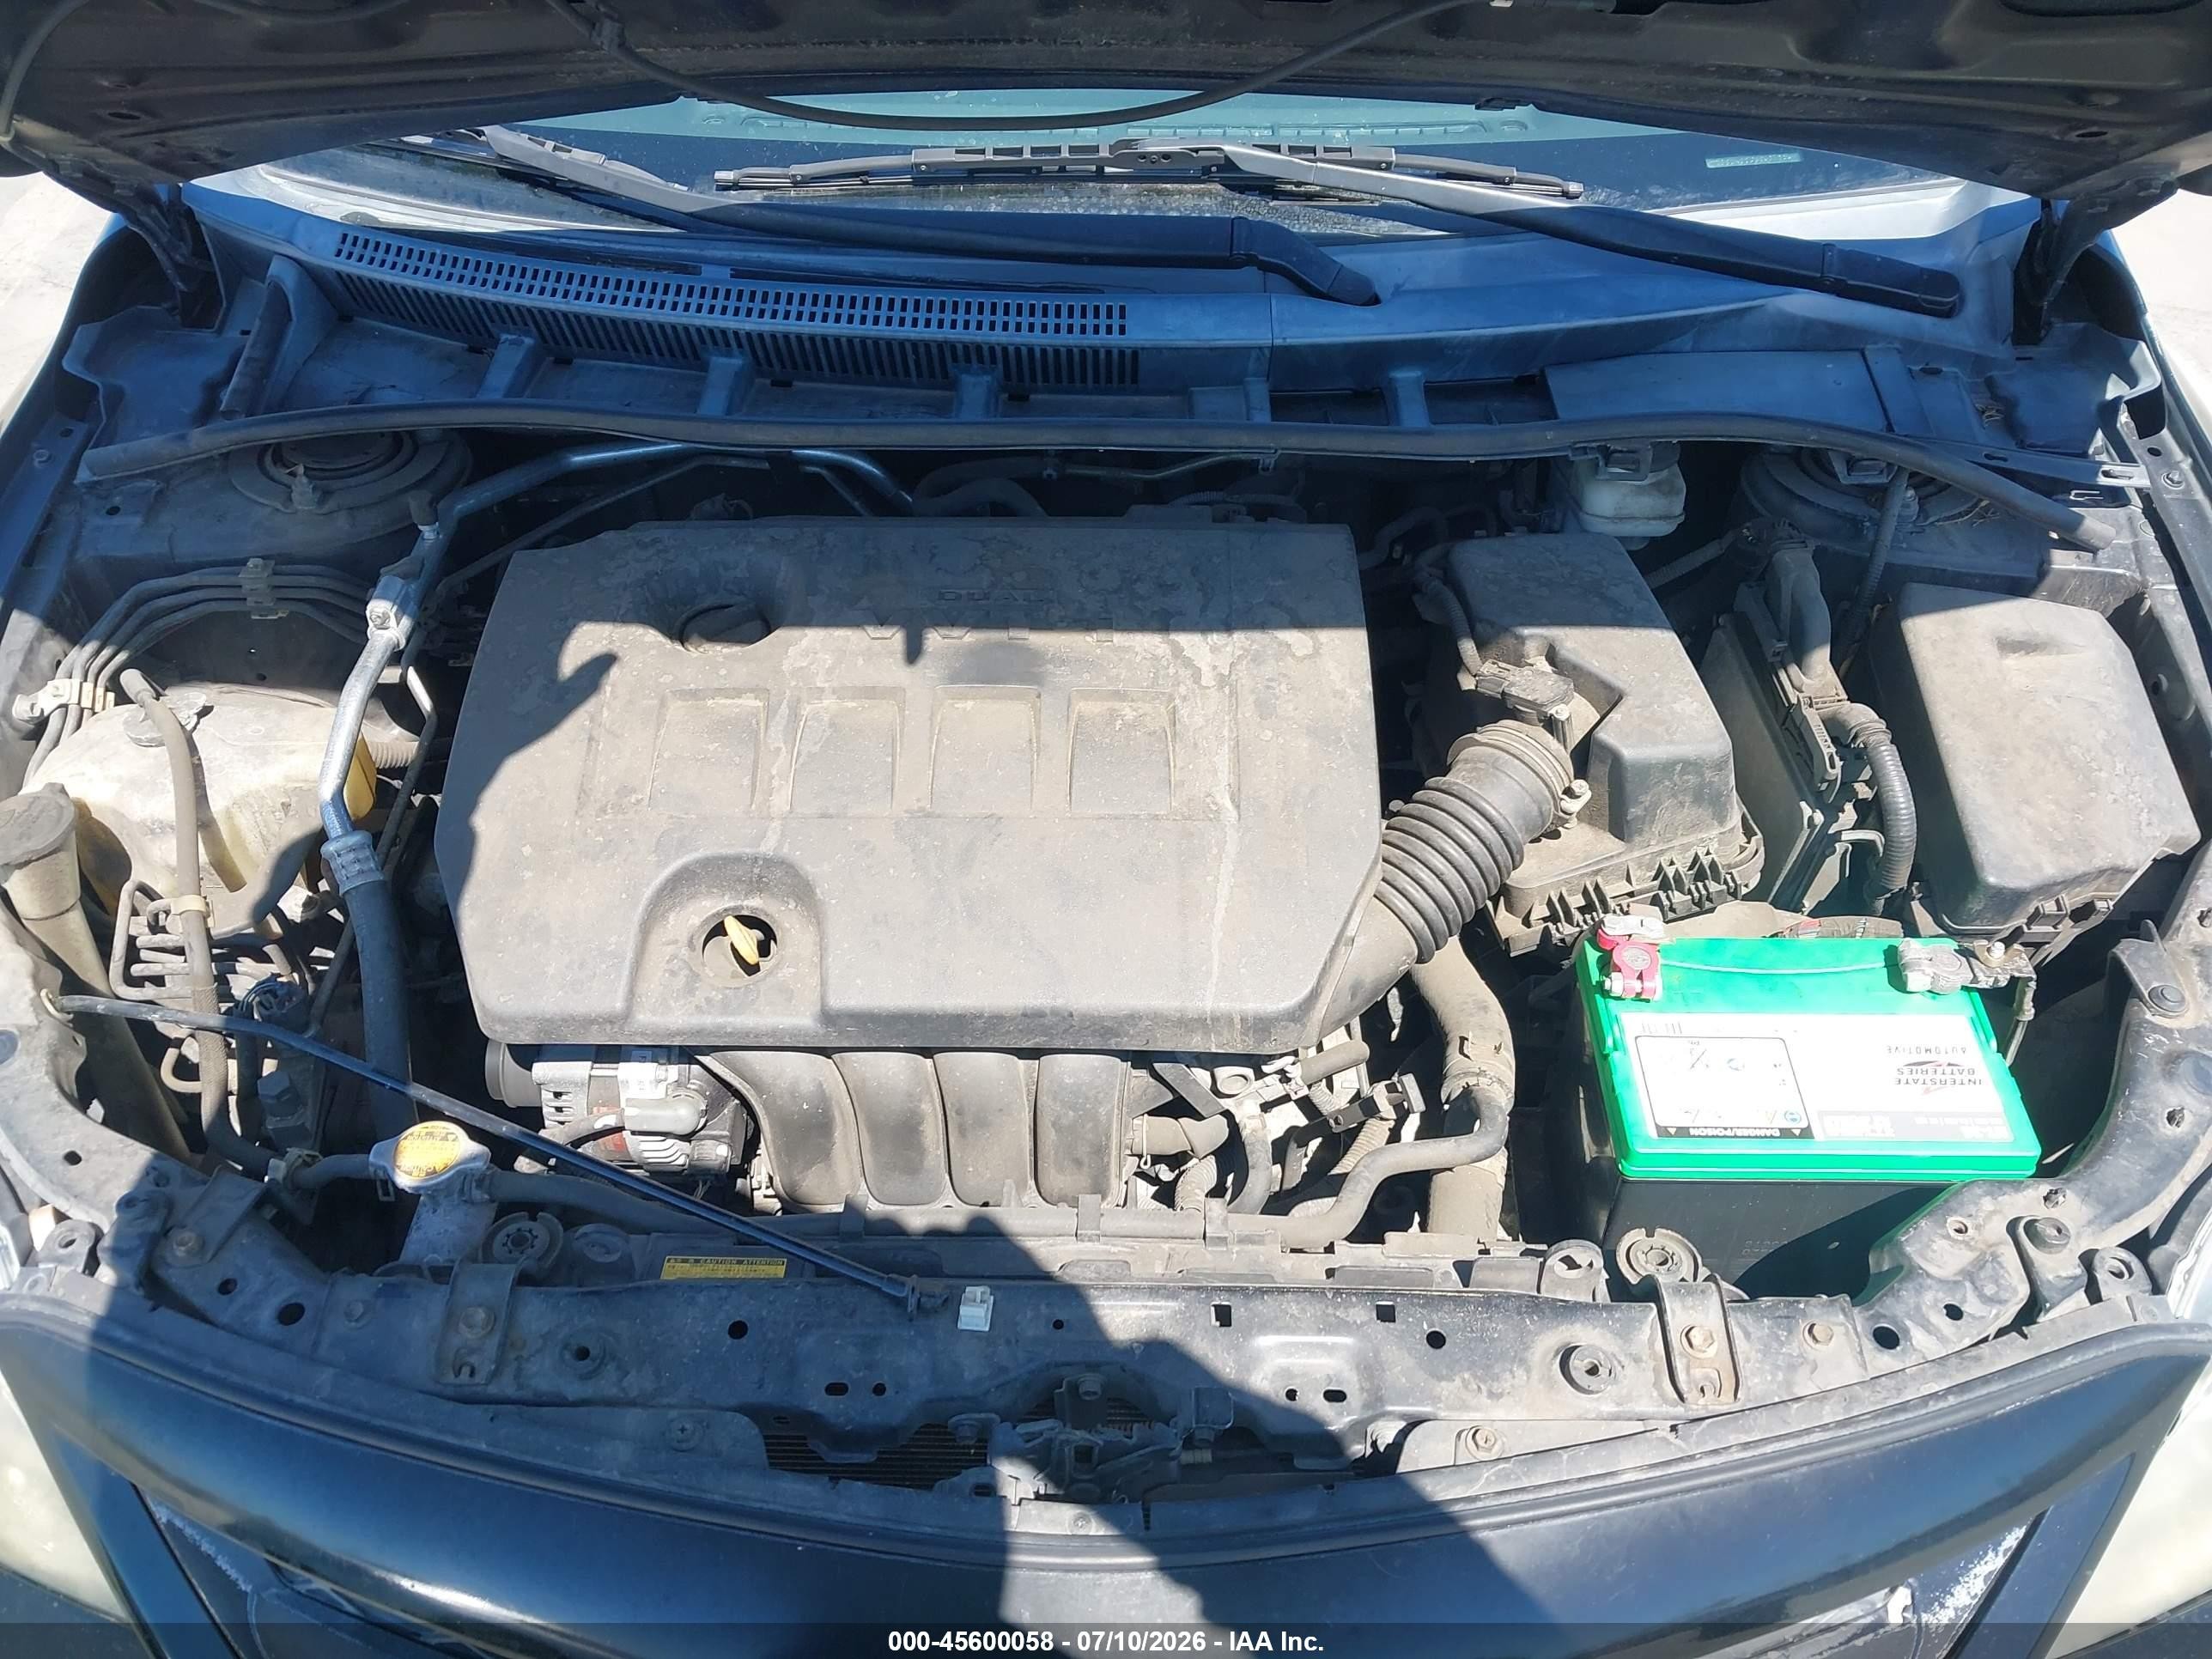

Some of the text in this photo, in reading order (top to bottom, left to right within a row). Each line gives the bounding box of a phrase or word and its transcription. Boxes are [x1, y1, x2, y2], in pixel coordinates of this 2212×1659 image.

[1887, 1046, 1966, 1054] AUTOMOTIVE
[1897, 1067, 1975, 1076] BATTERIES
[1689, 1127, 1780, 1136] DANGER/POISON
